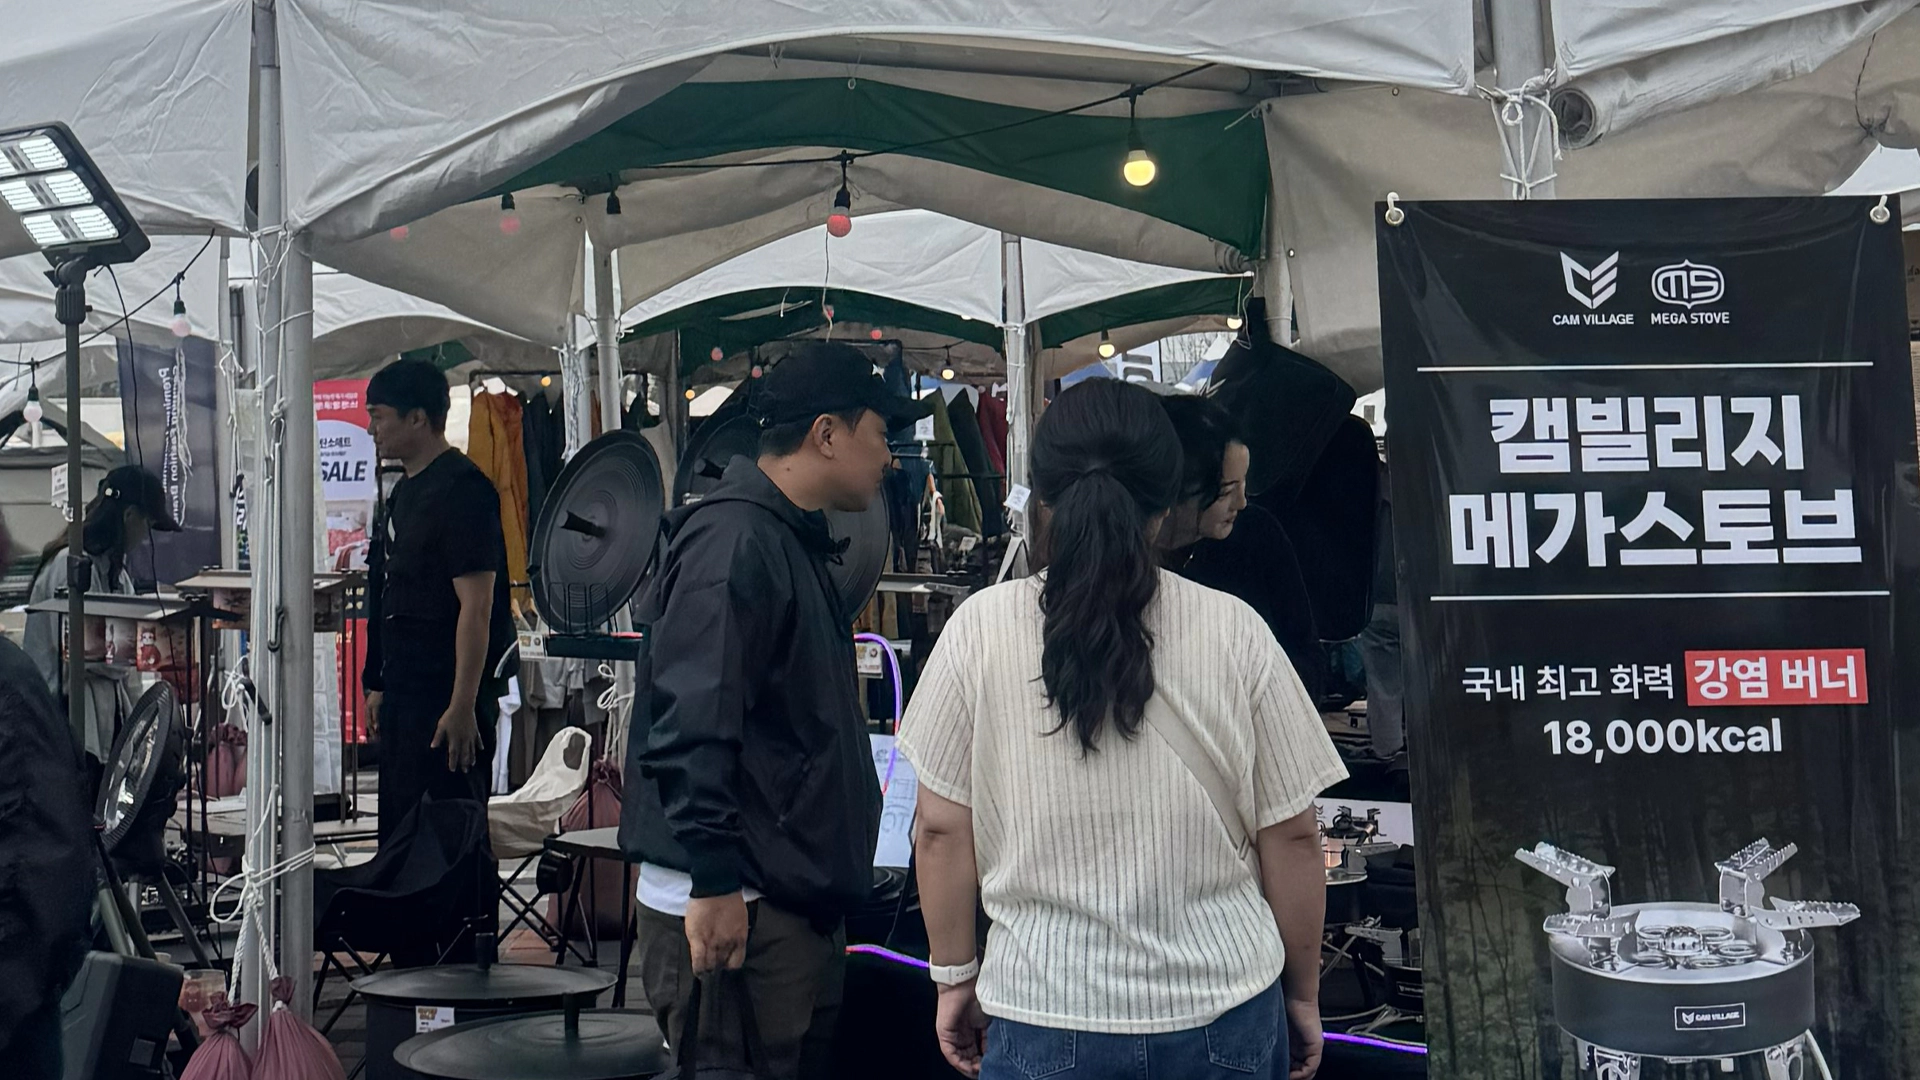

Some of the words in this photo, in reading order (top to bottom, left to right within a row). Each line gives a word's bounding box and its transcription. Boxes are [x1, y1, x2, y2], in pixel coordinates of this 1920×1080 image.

[1552, 314, 1580, 325] CAM
[1582, 313, 1635, 325] VILLAGE
[1650, 312, 1688, 325] MEGA
[1690, 311, 1730, 324] STOVE
[1490, 394, 1805, 473] 캠빌리지
[321, 461, 368, 482] SALE
[1449, 489, 1862, 568] 메가스토브
[1462, 665, 1526, 702] 국내
[1536, 664, 1602, 701] 최고
[1609, 663, 1674, 700] 화력
[1694, 656, 1769, 700] 강염
[1781, 655, 1857, 698] 버너
[1543, 717, 1782, 763] 18,000kcal
[1711, 1011, 1740, 1021] VILLAGE
